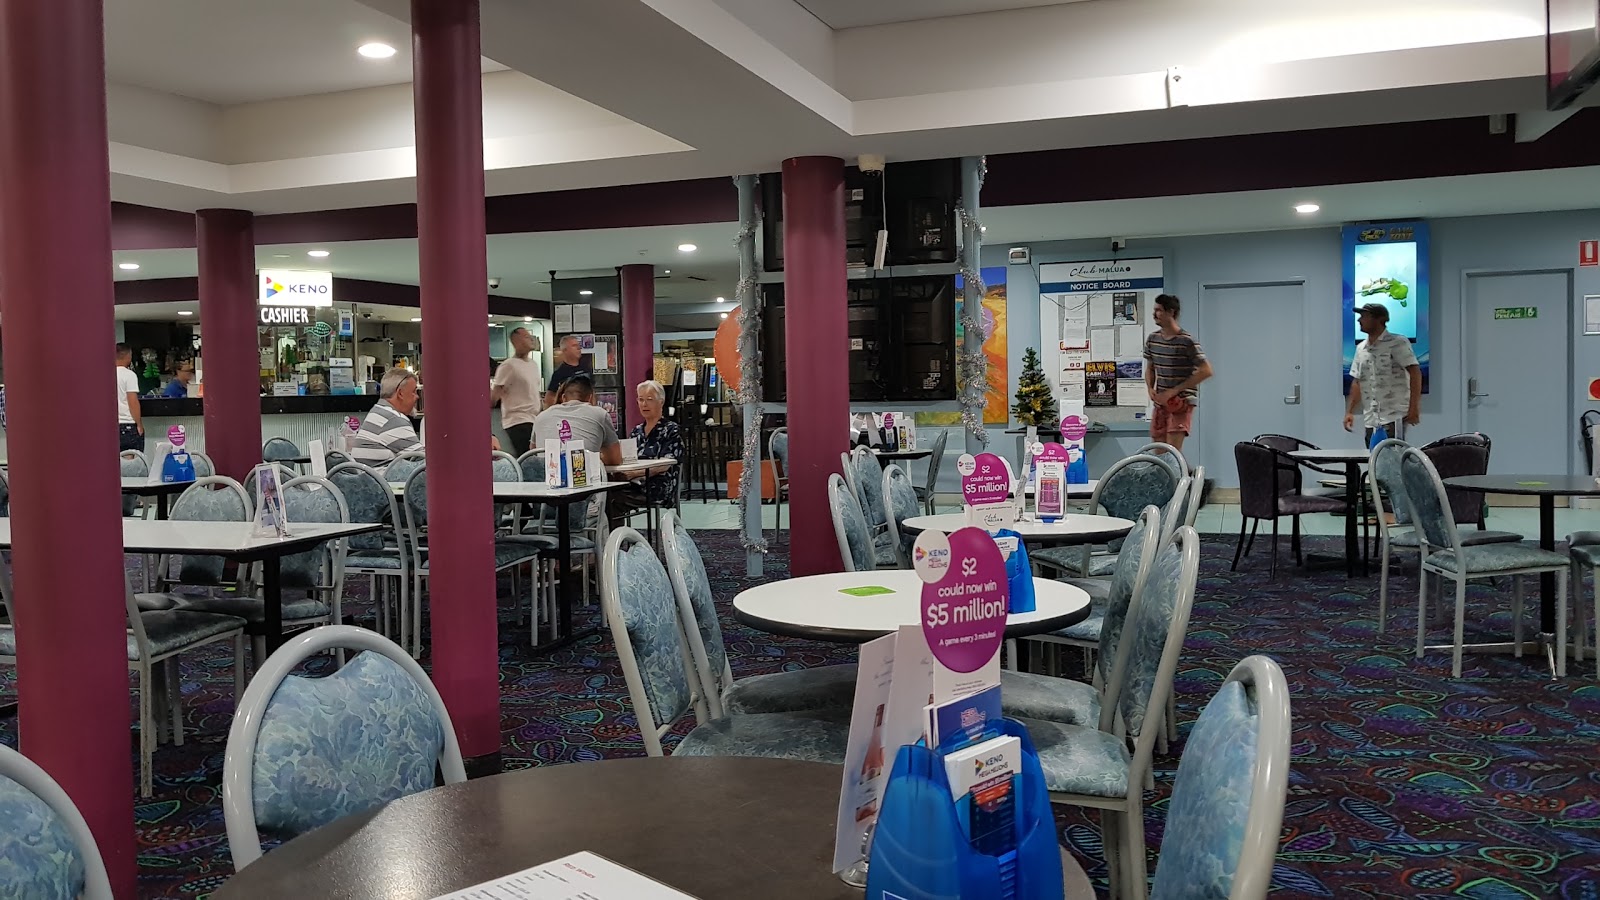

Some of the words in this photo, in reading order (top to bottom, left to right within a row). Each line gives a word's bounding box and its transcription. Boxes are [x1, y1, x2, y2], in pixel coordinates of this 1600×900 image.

[289, 284, 328, 294] KENO
[1070, 282, 1099, 291] NOTICE
[1102, 281, 1131, 289] BOARD
[260, 307, 309, 323] CASHIER
[1086, 362, 1115, 372] ELVIS
[981, 465, 990, 474] $2
[965, 484, 976, 494] $5
[978, 482, 1008, 492] million!
[928, 548, 948, 556] KENO
[962, 557, 977, 577] $2
[938, 582, 964, 598] could
[966, 584, 983, 594] now
[984, 580, 997, 592] win
[926, 602, 949, 628] $5
[953, 595, 1005, 624] million!
[945, 638, 959, 646] game
[960, 636, 974, 644] every
[974, 633, 978, 641] 3
[978, 630, 996, 640] minutes!
[986, 754, 1004, 766] KENO
